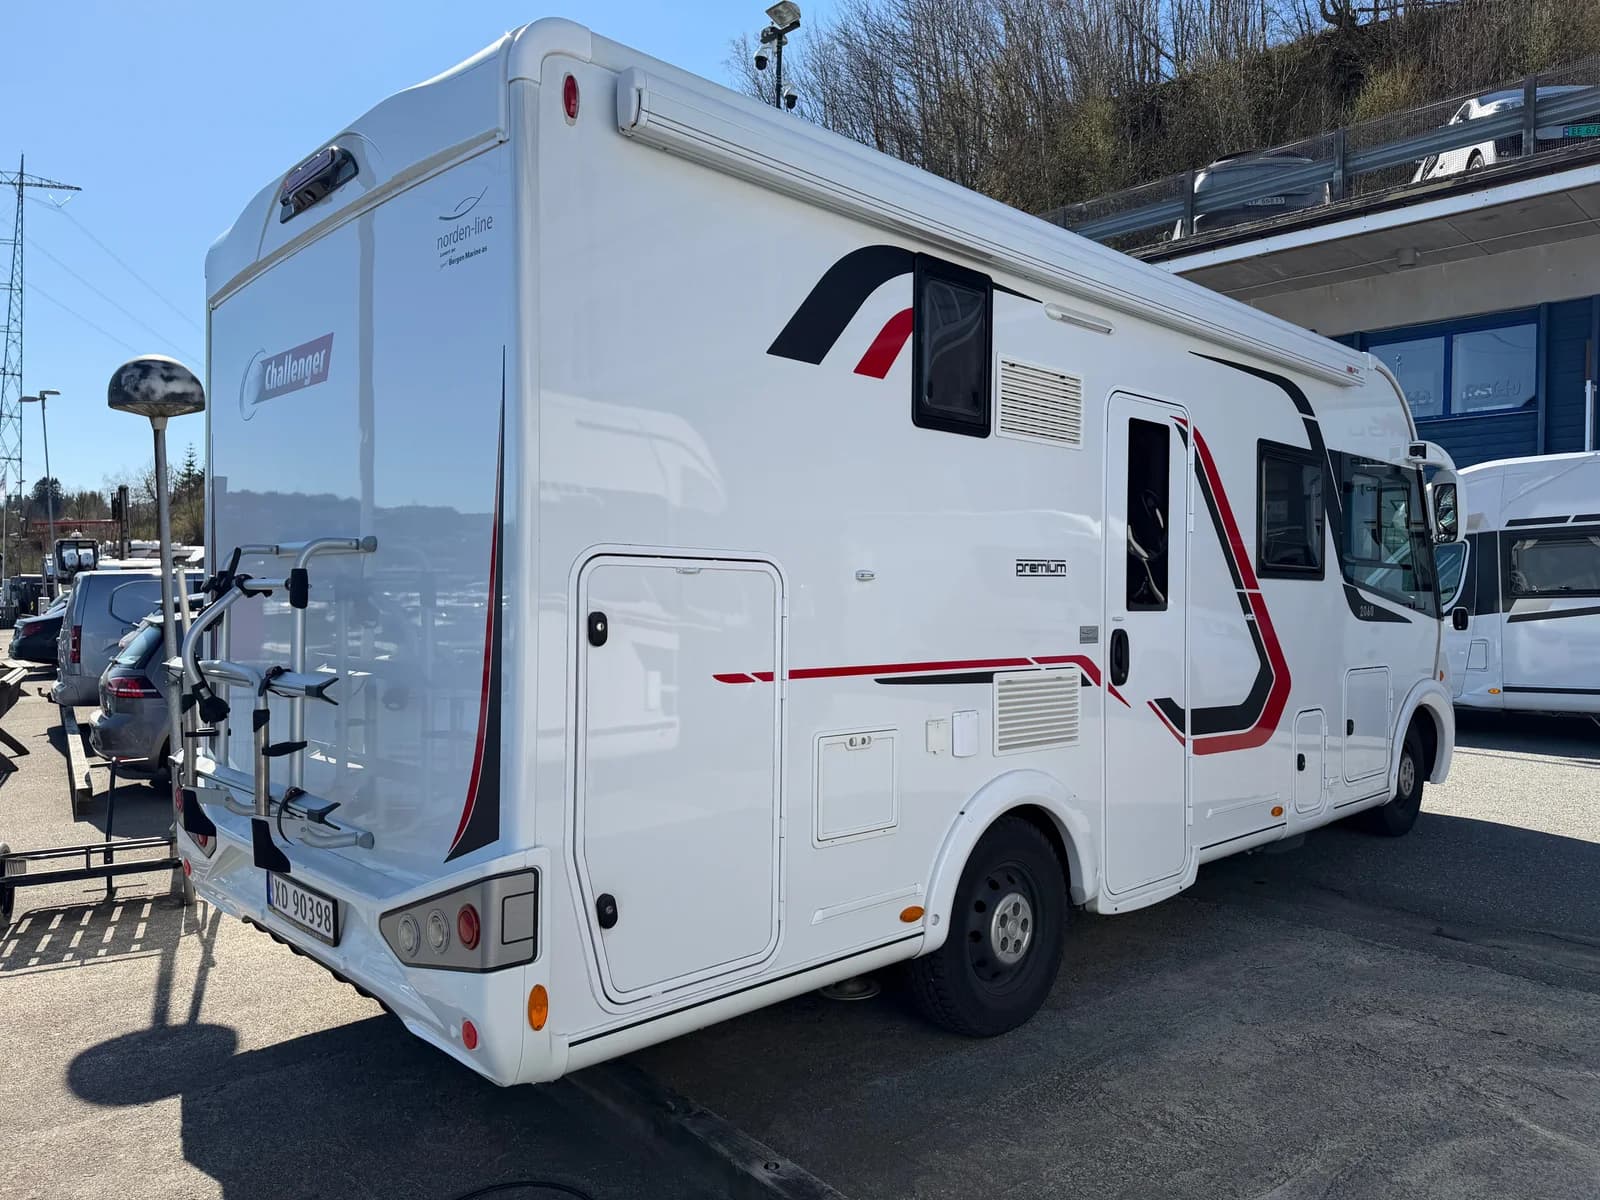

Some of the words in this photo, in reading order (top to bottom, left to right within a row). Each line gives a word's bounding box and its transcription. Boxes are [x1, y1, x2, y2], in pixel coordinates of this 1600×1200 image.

[436, 215, 494, 250] norden-line
[264, 348, 327, 391] Challenger
[1015, 559, 1067, 577] premium
[274, 878, 289, 910] XD
[292, 889, 332, 933] 90398
